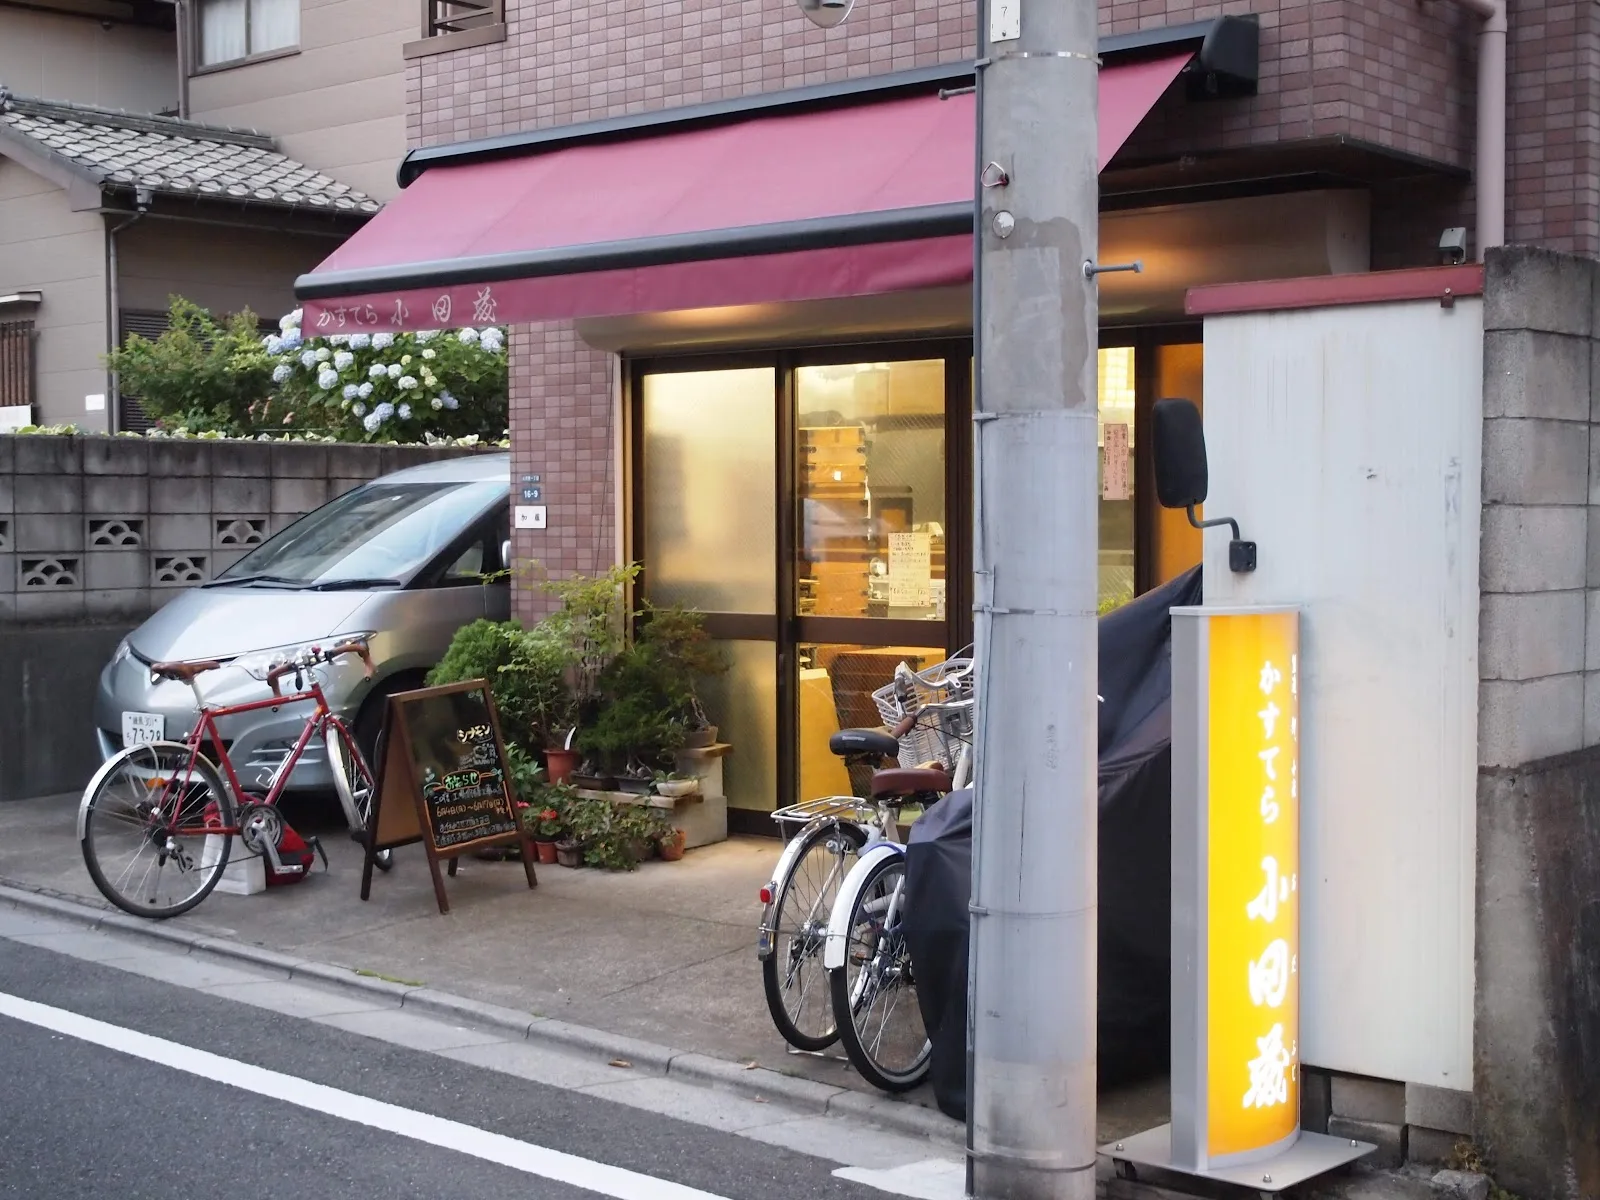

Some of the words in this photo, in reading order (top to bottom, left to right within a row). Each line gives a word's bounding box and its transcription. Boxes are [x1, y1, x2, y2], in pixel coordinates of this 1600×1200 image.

[1001, 6, 1008, 17] 7
[316, 303, 378, 327] かすてら
[524, 489, 539, 499] 16-9
[458, 724, 491, 743] シナモン
[1257, 659, 1282, 825] かすてら
